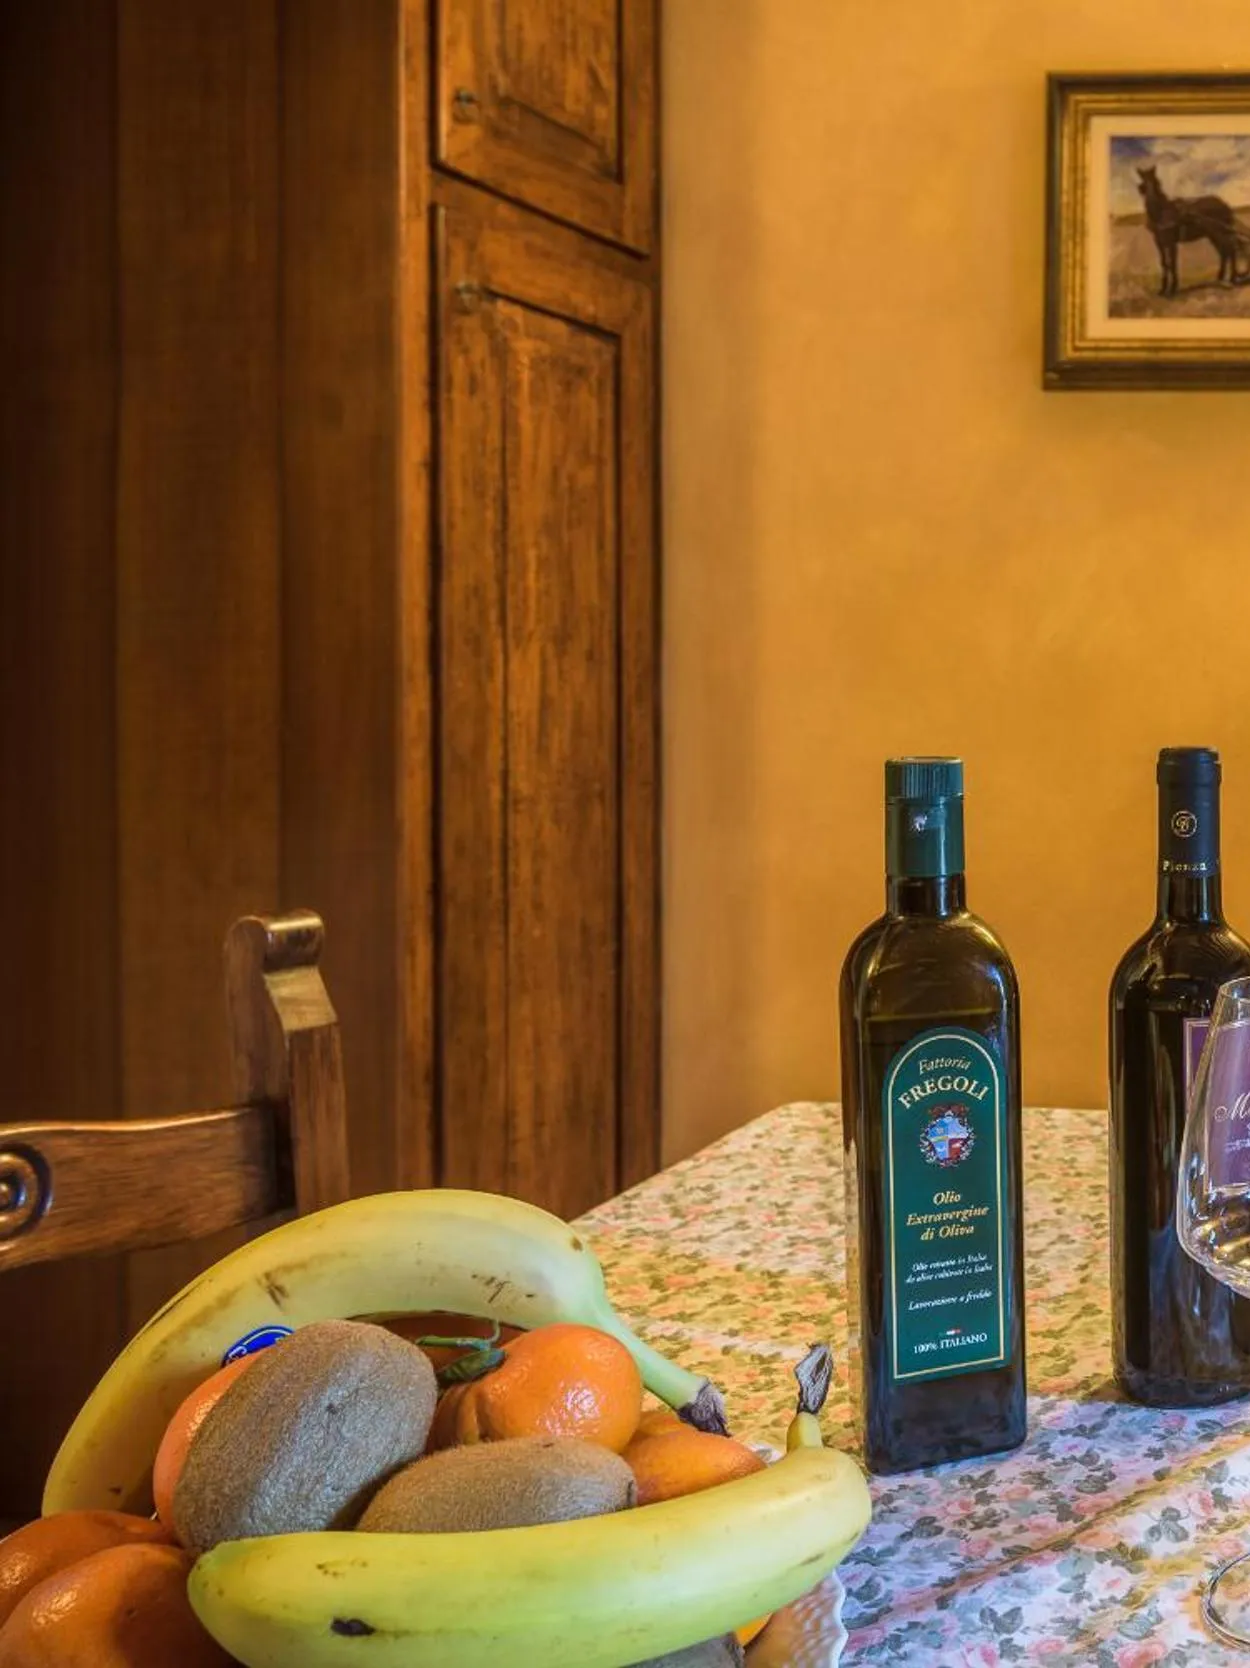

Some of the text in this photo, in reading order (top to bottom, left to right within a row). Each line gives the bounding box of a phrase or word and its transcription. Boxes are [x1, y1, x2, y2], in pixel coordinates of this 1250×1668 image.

[918, 1056, 972, 1075] Fattoria
[898, 1076, 990, 1110] FREGOLI
[933, 1191, 961, 1206] Olio
[906, 1205, 990, 1227] Extravergine
[920, 1223, 975, 1241] di Oliva
[913, 1332, 988, 1355] 100% ITALIANO
